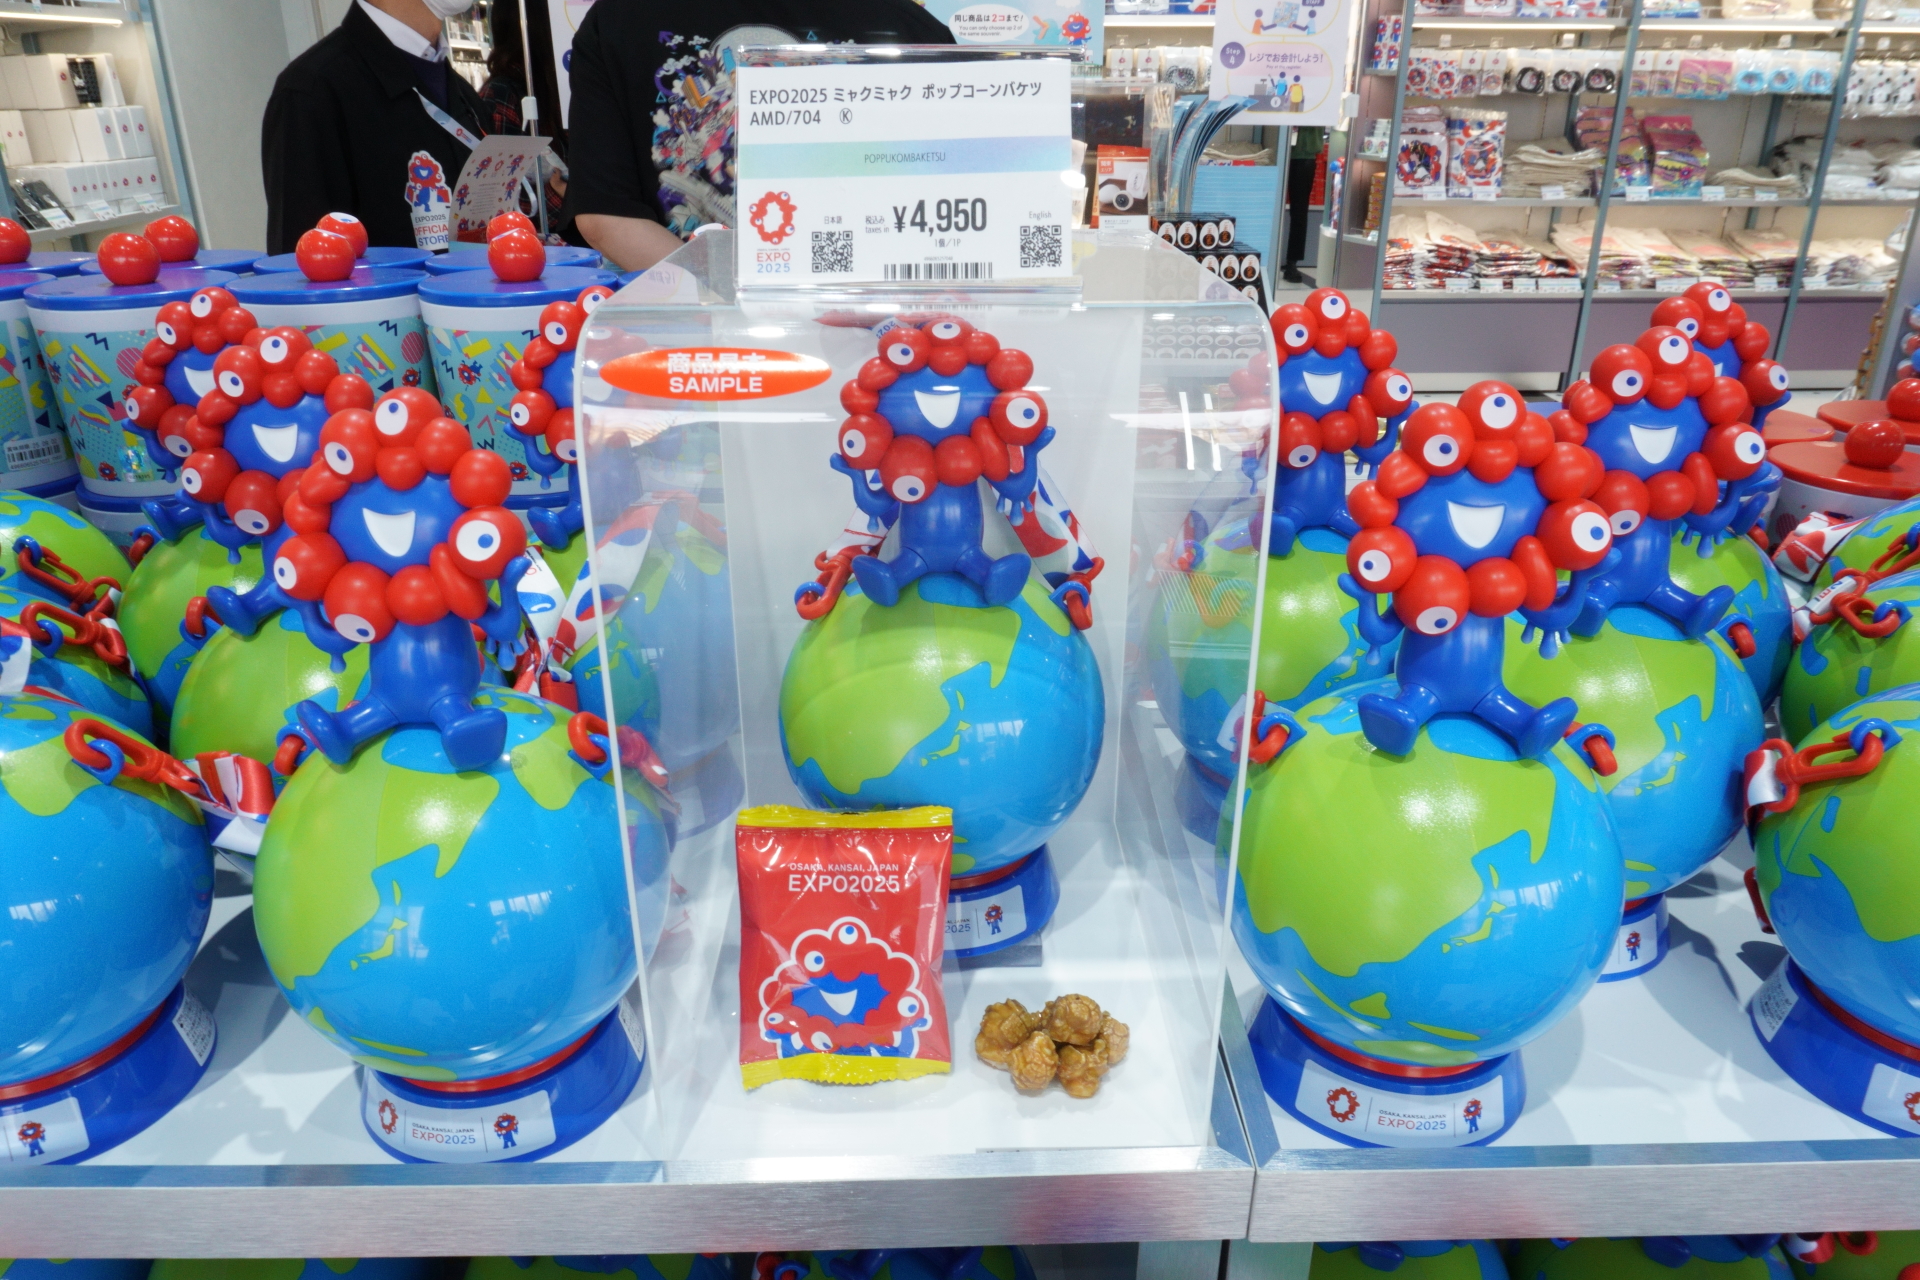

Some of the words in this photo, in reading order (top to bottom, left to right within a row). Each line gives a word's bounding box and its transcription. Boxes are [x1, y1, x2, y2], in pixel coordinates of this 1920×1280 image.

[1230, 56, 1235, 65] 4
[1249, 53, 1324, 63] レジでお会計しよう!
[750, 88, 828, 104] EXPO2025
[834, 85, 912, 102] ミャクミャク
[922, 81, 1042, 100] ポップコーンバケツ
[750, 110, 822, 126] AMD/704
[864, 152, 946, 164] POPPUKOMBAKETSU
[824, 216, 842, 225] 日本語
[866, 215, 885, 224] 税込み
[893, 197, 987, 237] ¥4,950
[1029, 211, 1052, 220] English
[414, 224, 449, 236] OFFICIA
[884, 224, 890, 233] in
[756, 252, 791, 262] EXPO
[757, 263, 791, 274] 2025
[667, 352, 766, 374] 商品見本
[669, 376, 762, 393] SAMPLE
[789, 862, 826, 872] OSAKA,
[828, 863, 865, 872] KANSAI,
[866, 864, 899, 872] JAPAN
[788, 874, 900, 893] EXPO2025
[1378, 1116, 1446, 1130] EXPO2025
[412, 1128, 476, 1144] EXPO2025
